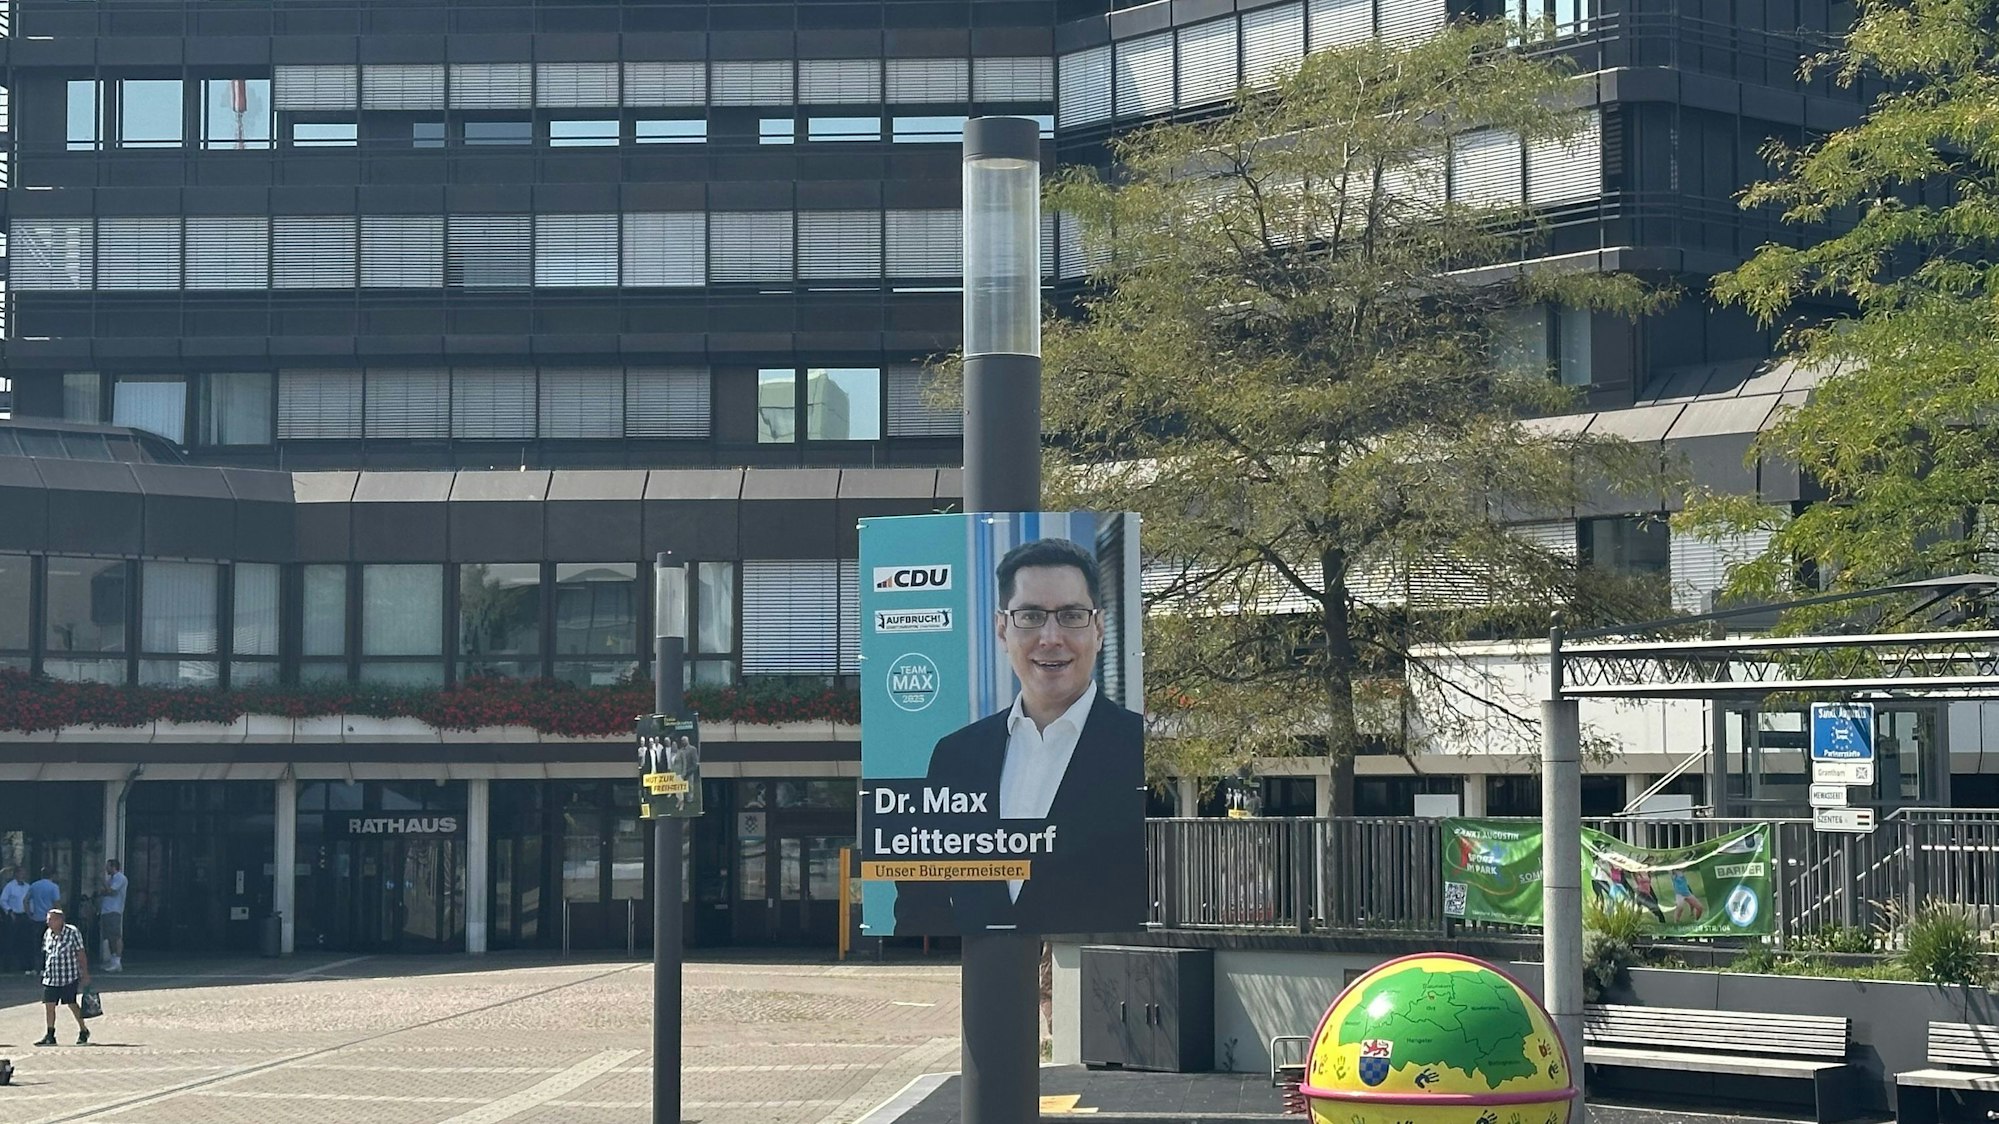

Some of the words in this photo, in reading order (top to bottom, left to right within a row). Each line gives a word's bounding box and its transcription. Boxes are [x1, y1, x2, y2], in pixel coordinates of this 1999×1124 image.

[894, 568, 948, 588] CDU
[900, 665, 927, 674] TEAM
[893, 674, 933, 690] MAX
[902, 695, 925, 703] 2025
[658, 775, 675, 783] ZUR
[1818, 768, 1845, 777] Grantham
[875, 787, 916, 814] Dr.
[923, 786, 988, 813] Max
[349, 817, 457, 833] RATHAUS
[875, 825, 1057, 855] Leitterstorf
[875, 864, 917, 877] Unser
[919, 863, 1025, 880] Bürgermeister.
[1475, 864, 1498, 875] PARK
